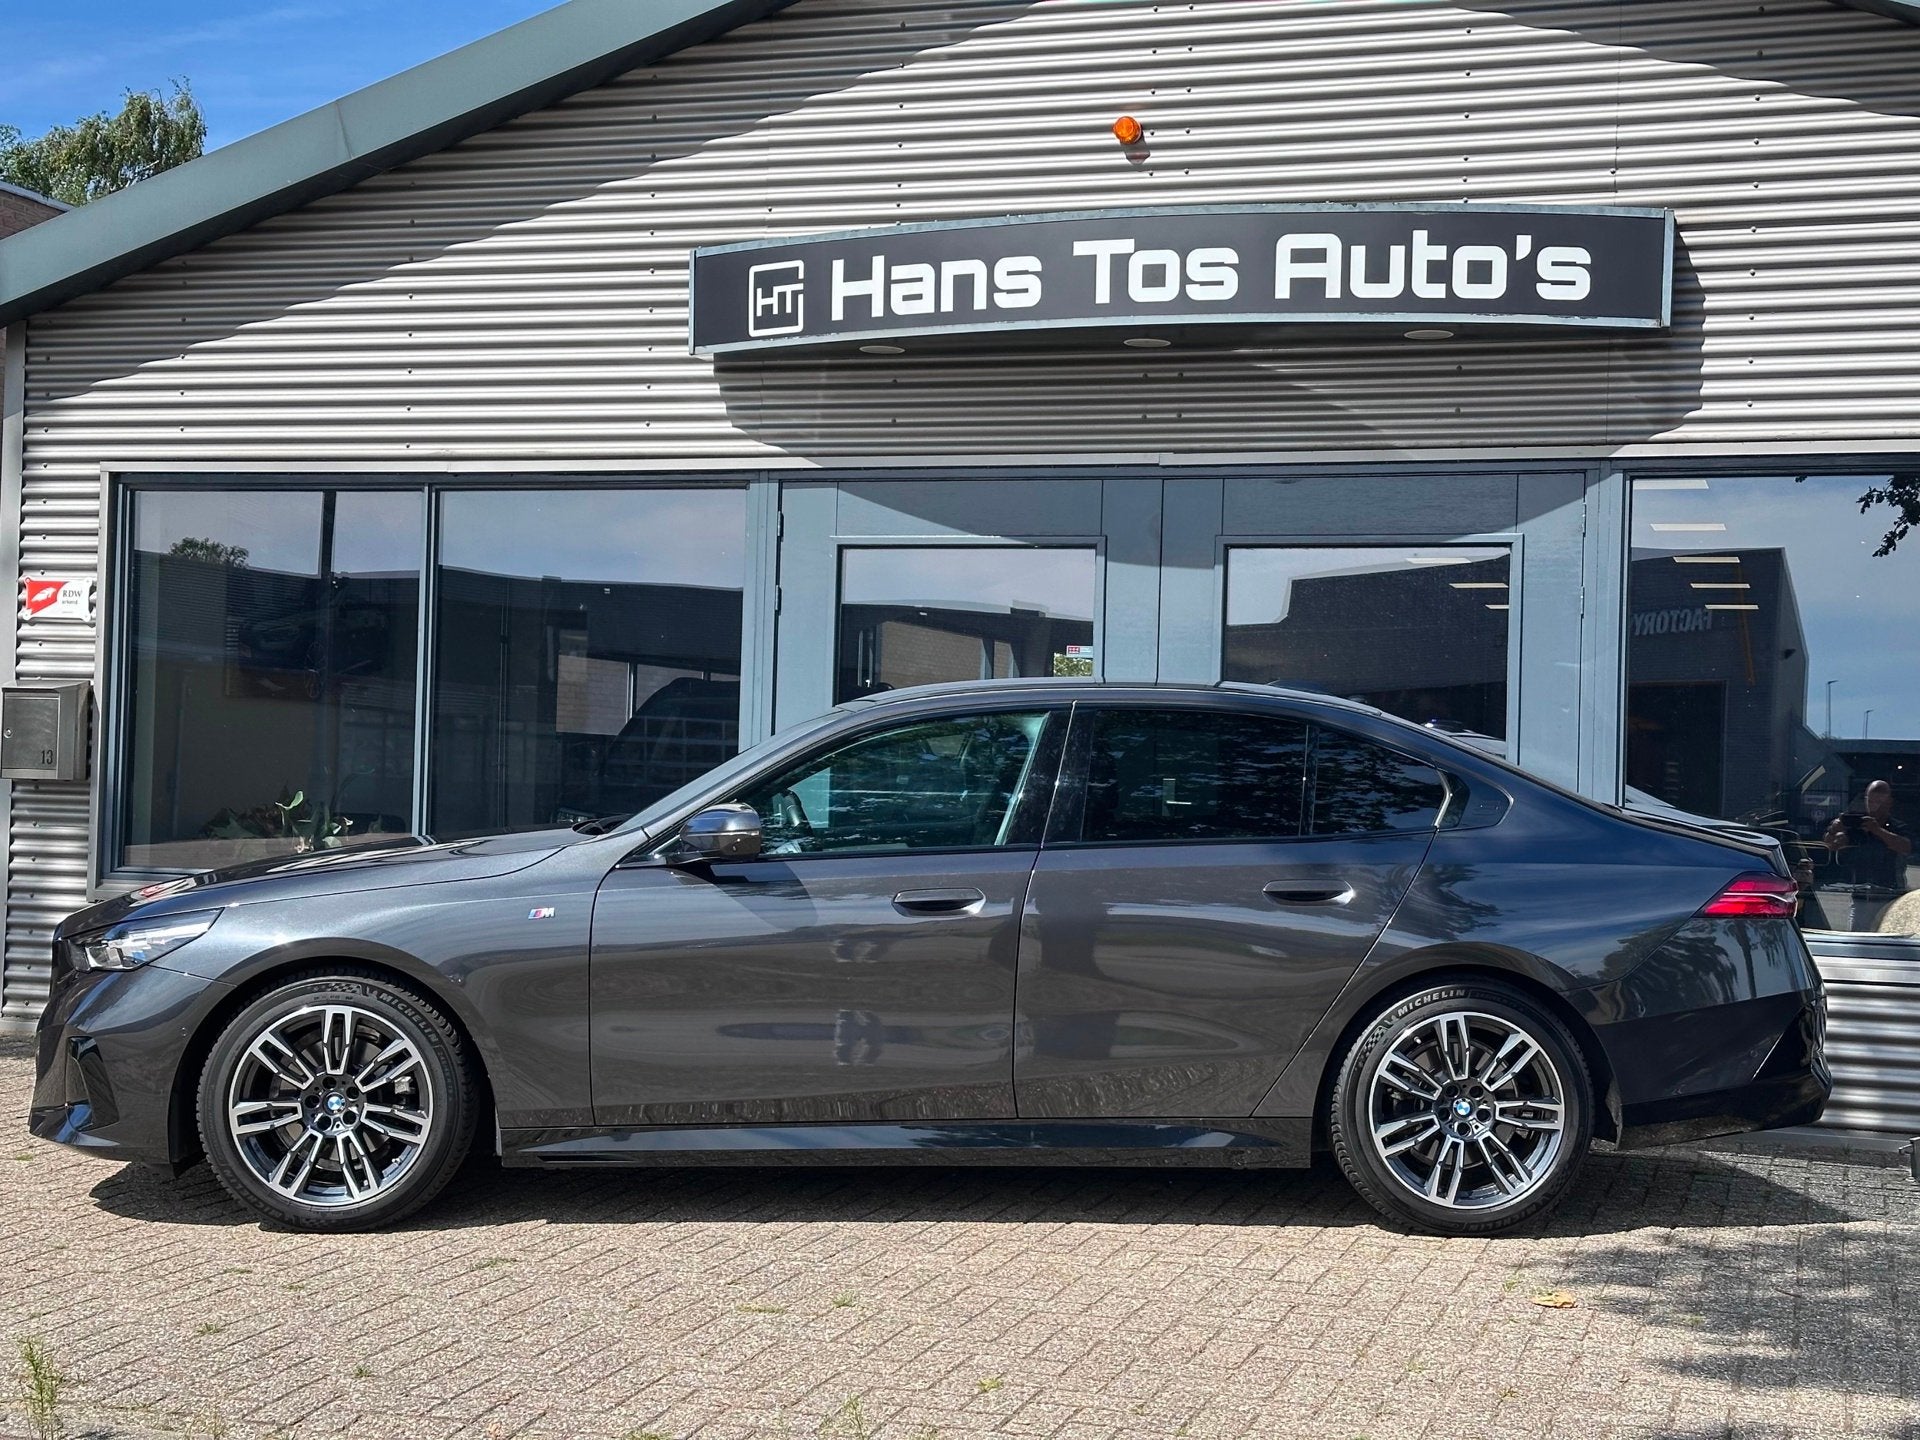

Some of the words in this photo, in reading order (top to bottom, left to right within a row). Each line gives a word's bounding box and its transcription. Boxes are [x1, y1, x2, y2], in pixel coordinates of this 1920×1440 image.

[831, 255, 1042, 321] Hans
[1073, 238, 1239, 304] Tos
[1274, 229, 1592, 301] Auto's
[62, 589, 82, 598] RDW
[41, 749, 54, 765] 13
[1396, 988, 1467, 1017] MICHELIN
[378, 992, 440, 1045] MICHELIN
[1468, 1203, 1538, 1231] MICHELIN
